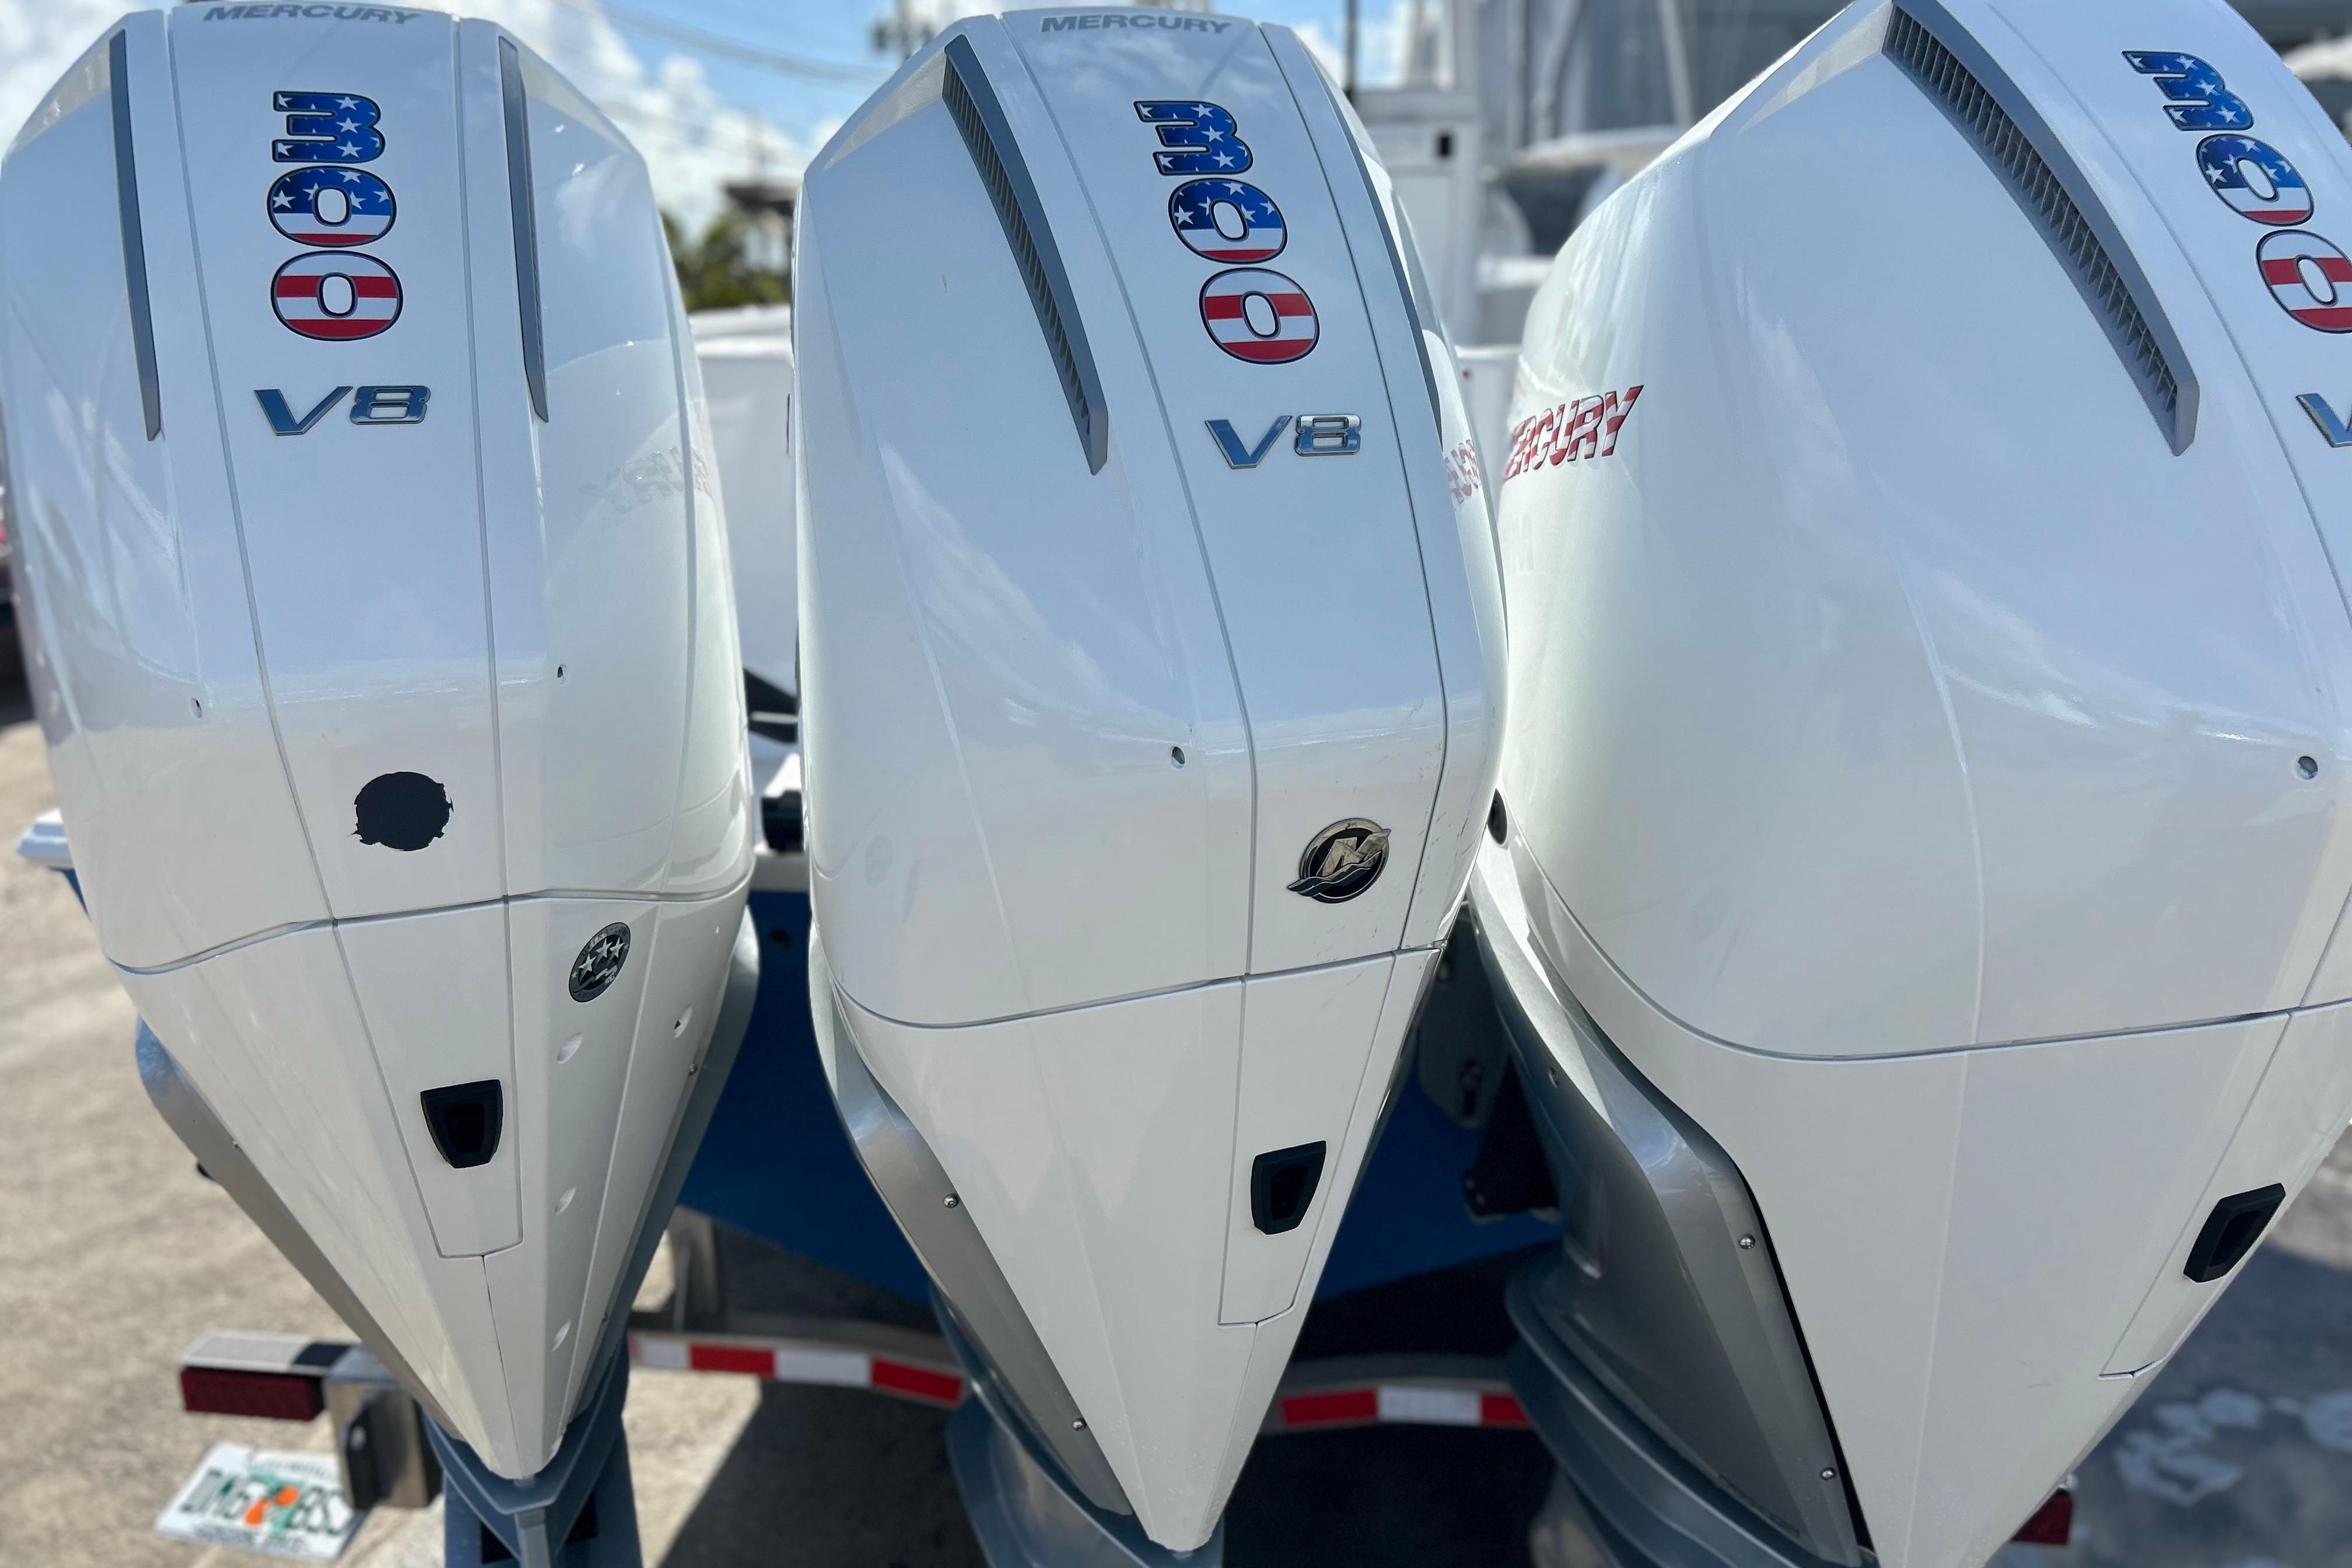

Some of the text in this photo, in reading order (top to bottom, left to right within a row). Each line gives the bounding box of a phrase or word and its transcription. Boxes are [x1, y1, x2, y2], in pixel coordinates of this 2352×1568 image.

[202, 4, 422, 24] MERCURY
[1040, 14, 1233, 33] MERCURY
[266, 90, 404, 342] 300
[2121, 50, 2352, 334] 300
[1133, 100, 1320, 365] 300
[253, 386, 431, 436] V8
[1204, 414, 1362, 469] V8
[1503, 384, 1644, 481] ERCURY
